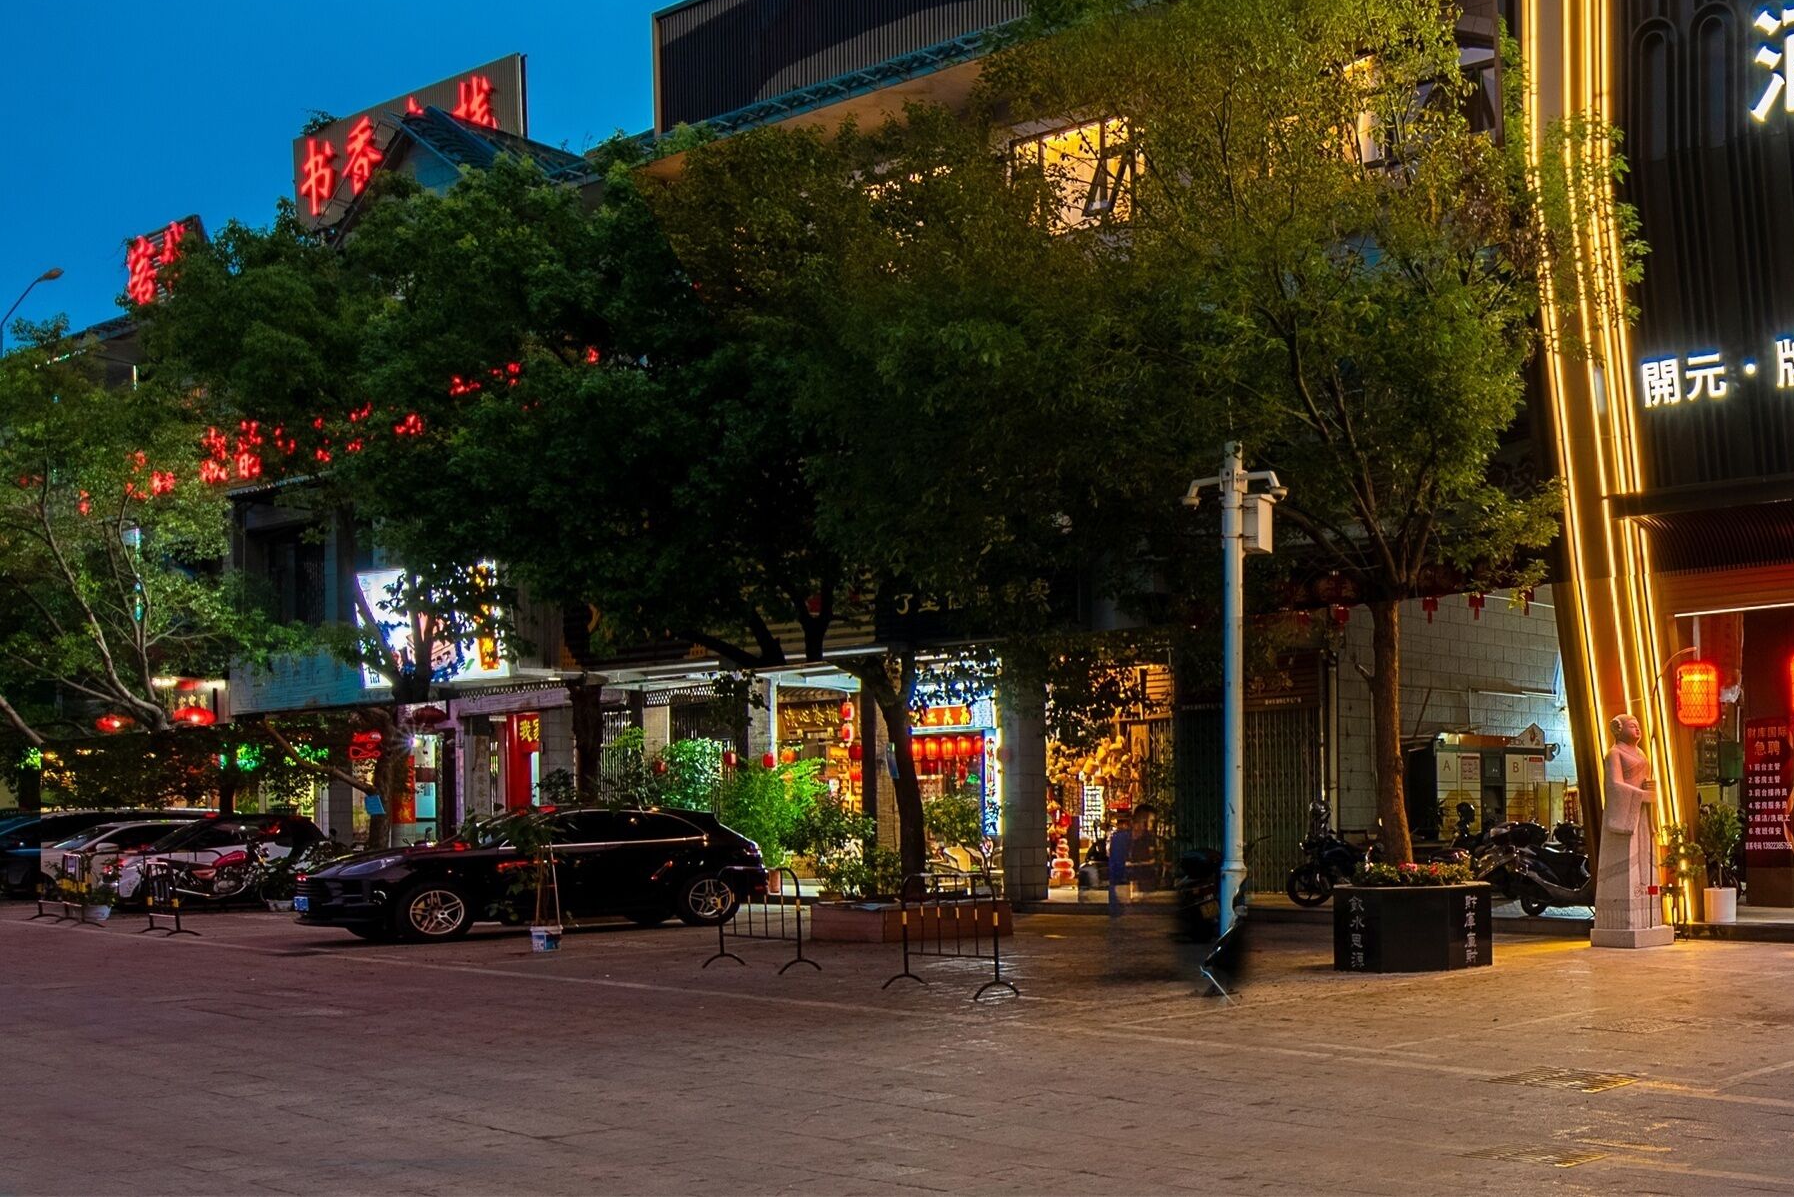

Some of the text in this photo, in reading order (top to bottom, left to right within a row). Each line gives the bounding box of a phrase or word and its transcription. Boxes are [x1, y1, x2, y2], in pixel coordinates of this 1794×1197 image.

[300, 75, 499, 216] 书香栈
[1443, 760, 1451, 771] A
[1512, 762, 1520, 773] B
